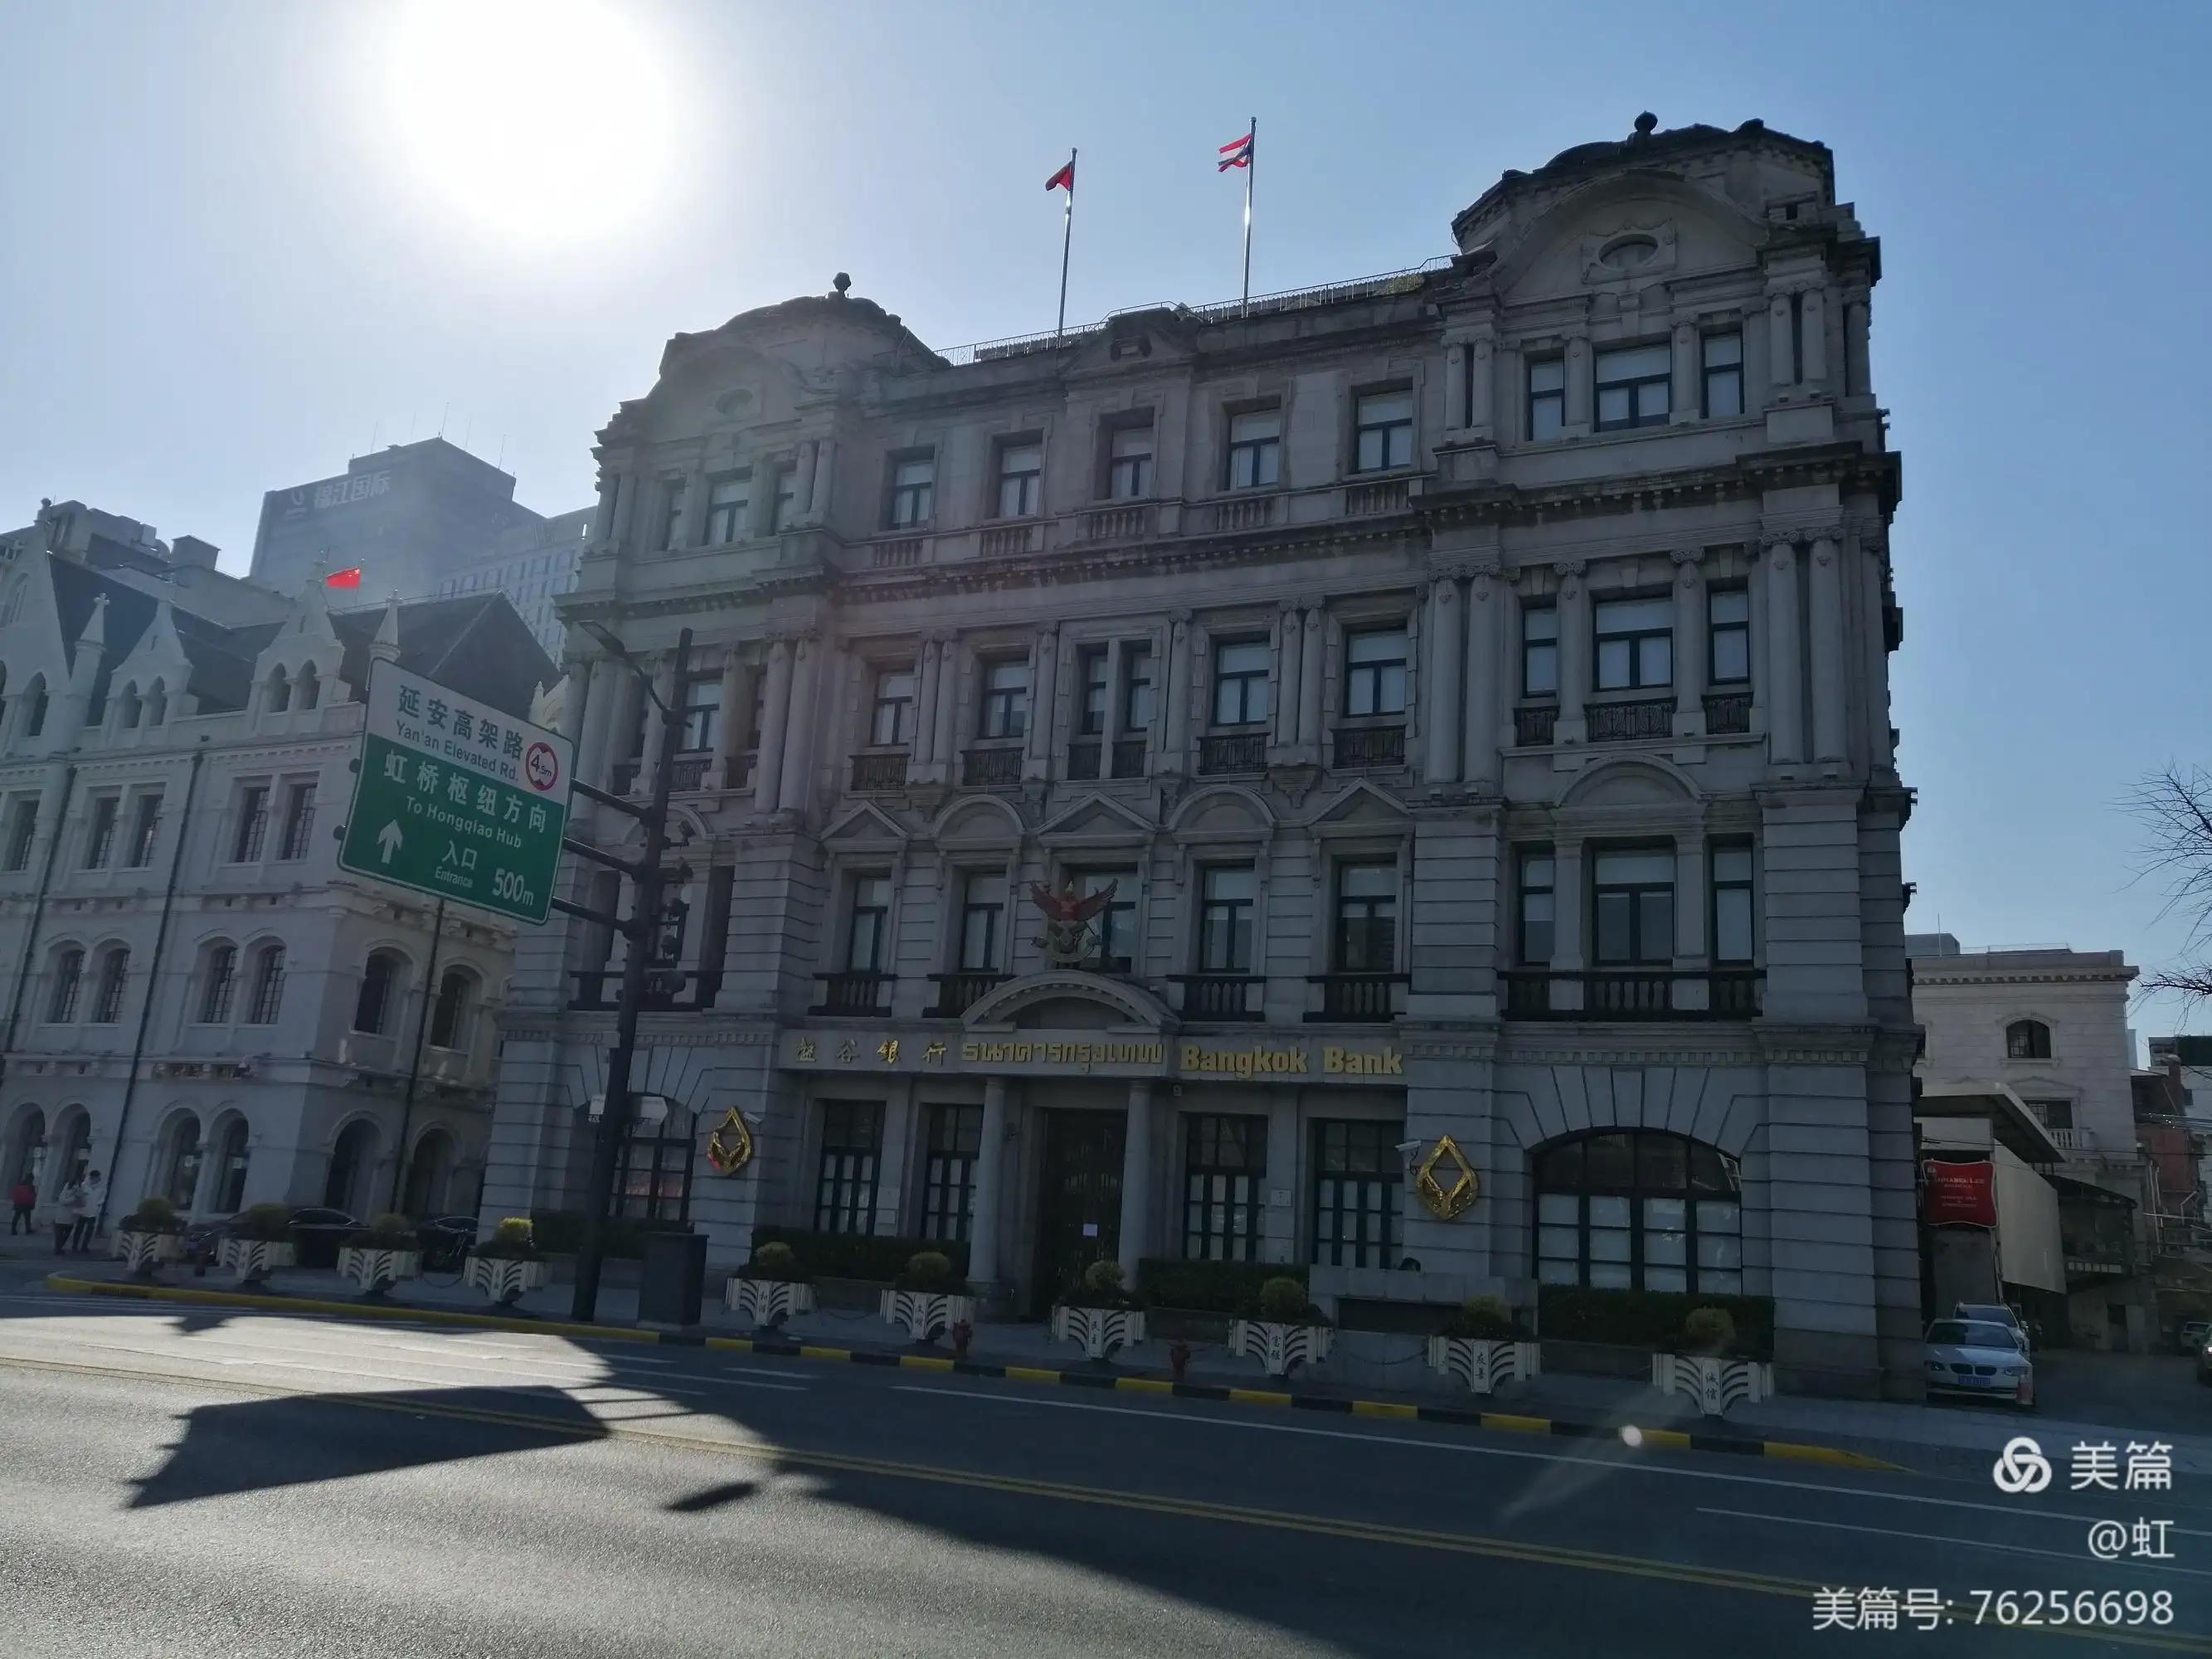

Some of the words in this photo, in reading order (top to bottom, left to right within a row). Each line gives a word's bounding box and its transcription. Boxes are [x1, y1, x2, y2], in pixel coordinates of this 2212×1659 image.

[398, 684, 523, 761] 延安高架路
[396, 720, 439, 750] Yan'an
[445, 740, 496, 773] Elevated
[499, 759, 518, 781] Rd.
[383, 748, 547, 834] 虹桥枢纽方向
[406, 795, 422, 814] To
[426, 805, 493, 839] Hongqiao
[496, 830, 523, 849] Hub
[435, 865, 474, 889] Entrance
[441, 839, 478, 870] 入口
[492, 867, 535, 907] 500m
[1179, 1044, 1308, 1078] Bangkok
[1322, 1046, 1403, 1075] Bank
